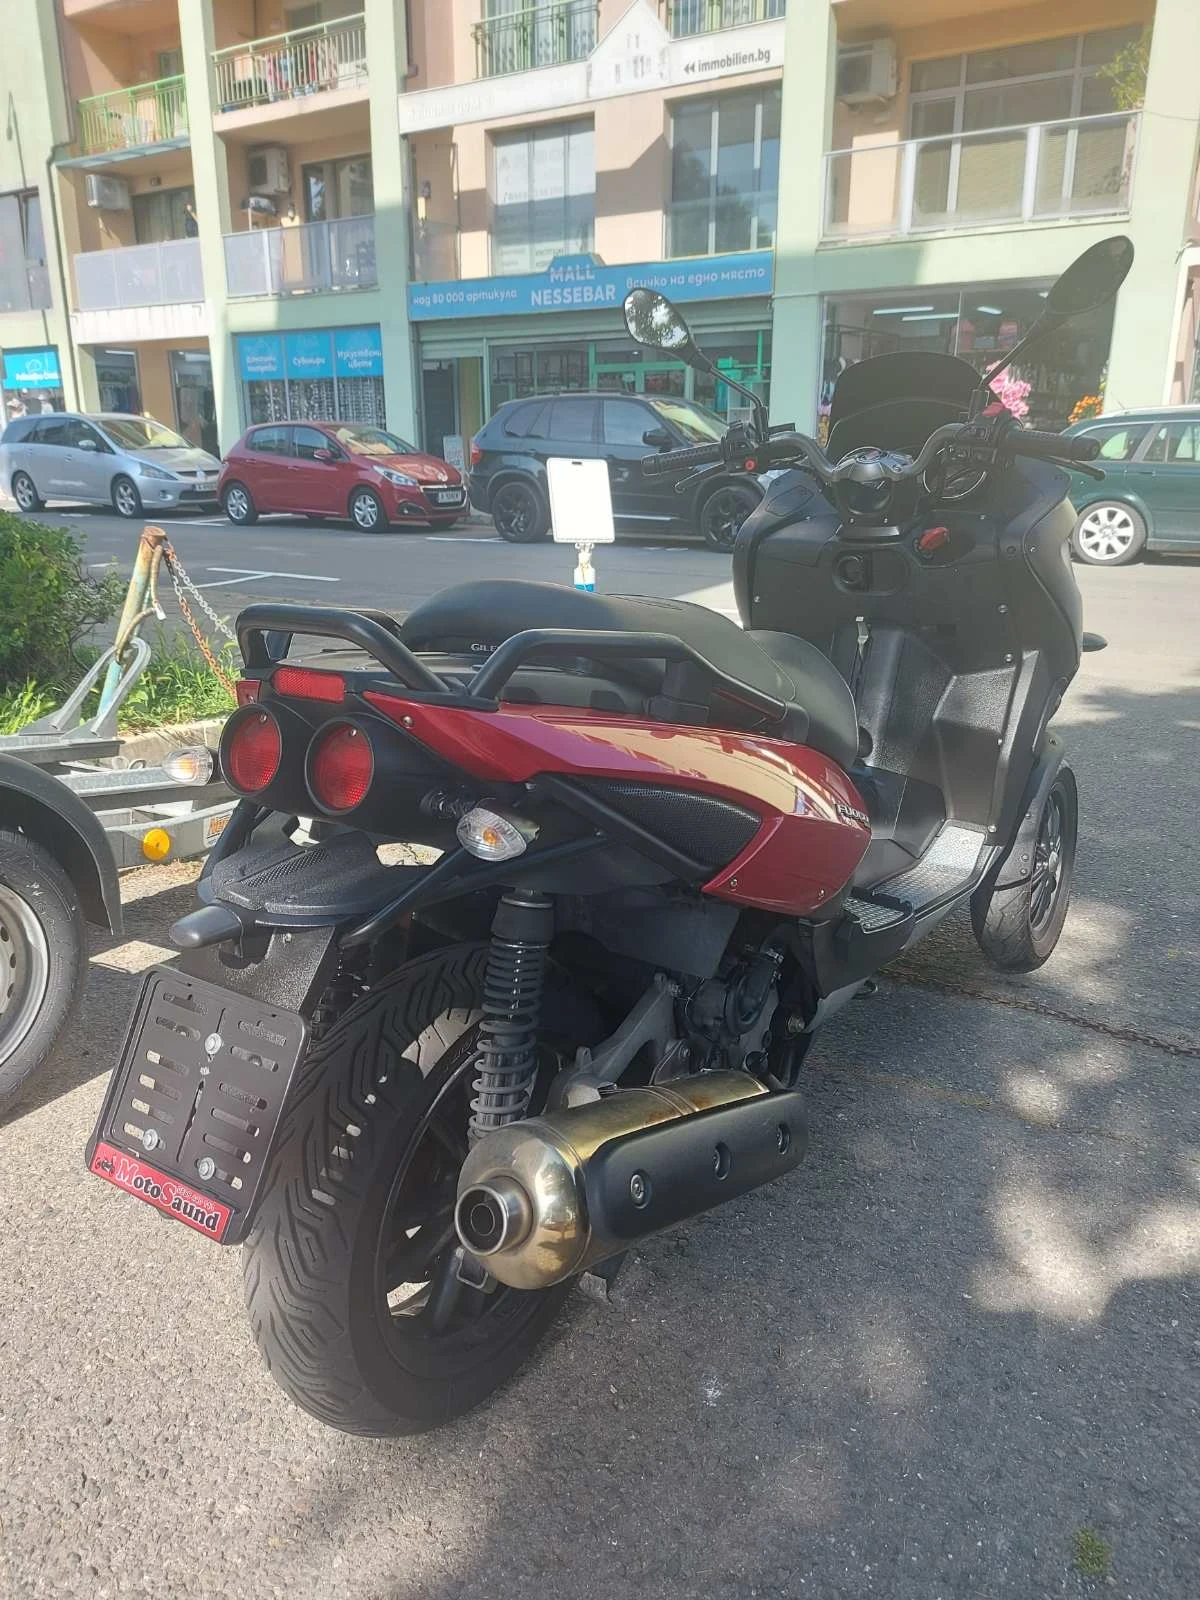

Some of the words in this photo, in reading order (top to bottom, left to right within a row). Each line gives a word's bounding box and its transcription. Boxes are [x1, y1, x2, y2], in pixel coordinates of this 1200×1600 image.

[698, 48, 771, 73] immobilien.bg
[550, 264, 595, 283] MALL
[670, 276, 685, 286] на
[688, 272, 718, 287] едно
[720, 267, 766, 281] място
[432, 292, 444, 304] 80
[446, 291, 465, 303] 000
[466, 288, 517, 304] артикула
[531, 284, 616, 307] NESSEBAR
[471, 643, 499, 652] GILE
